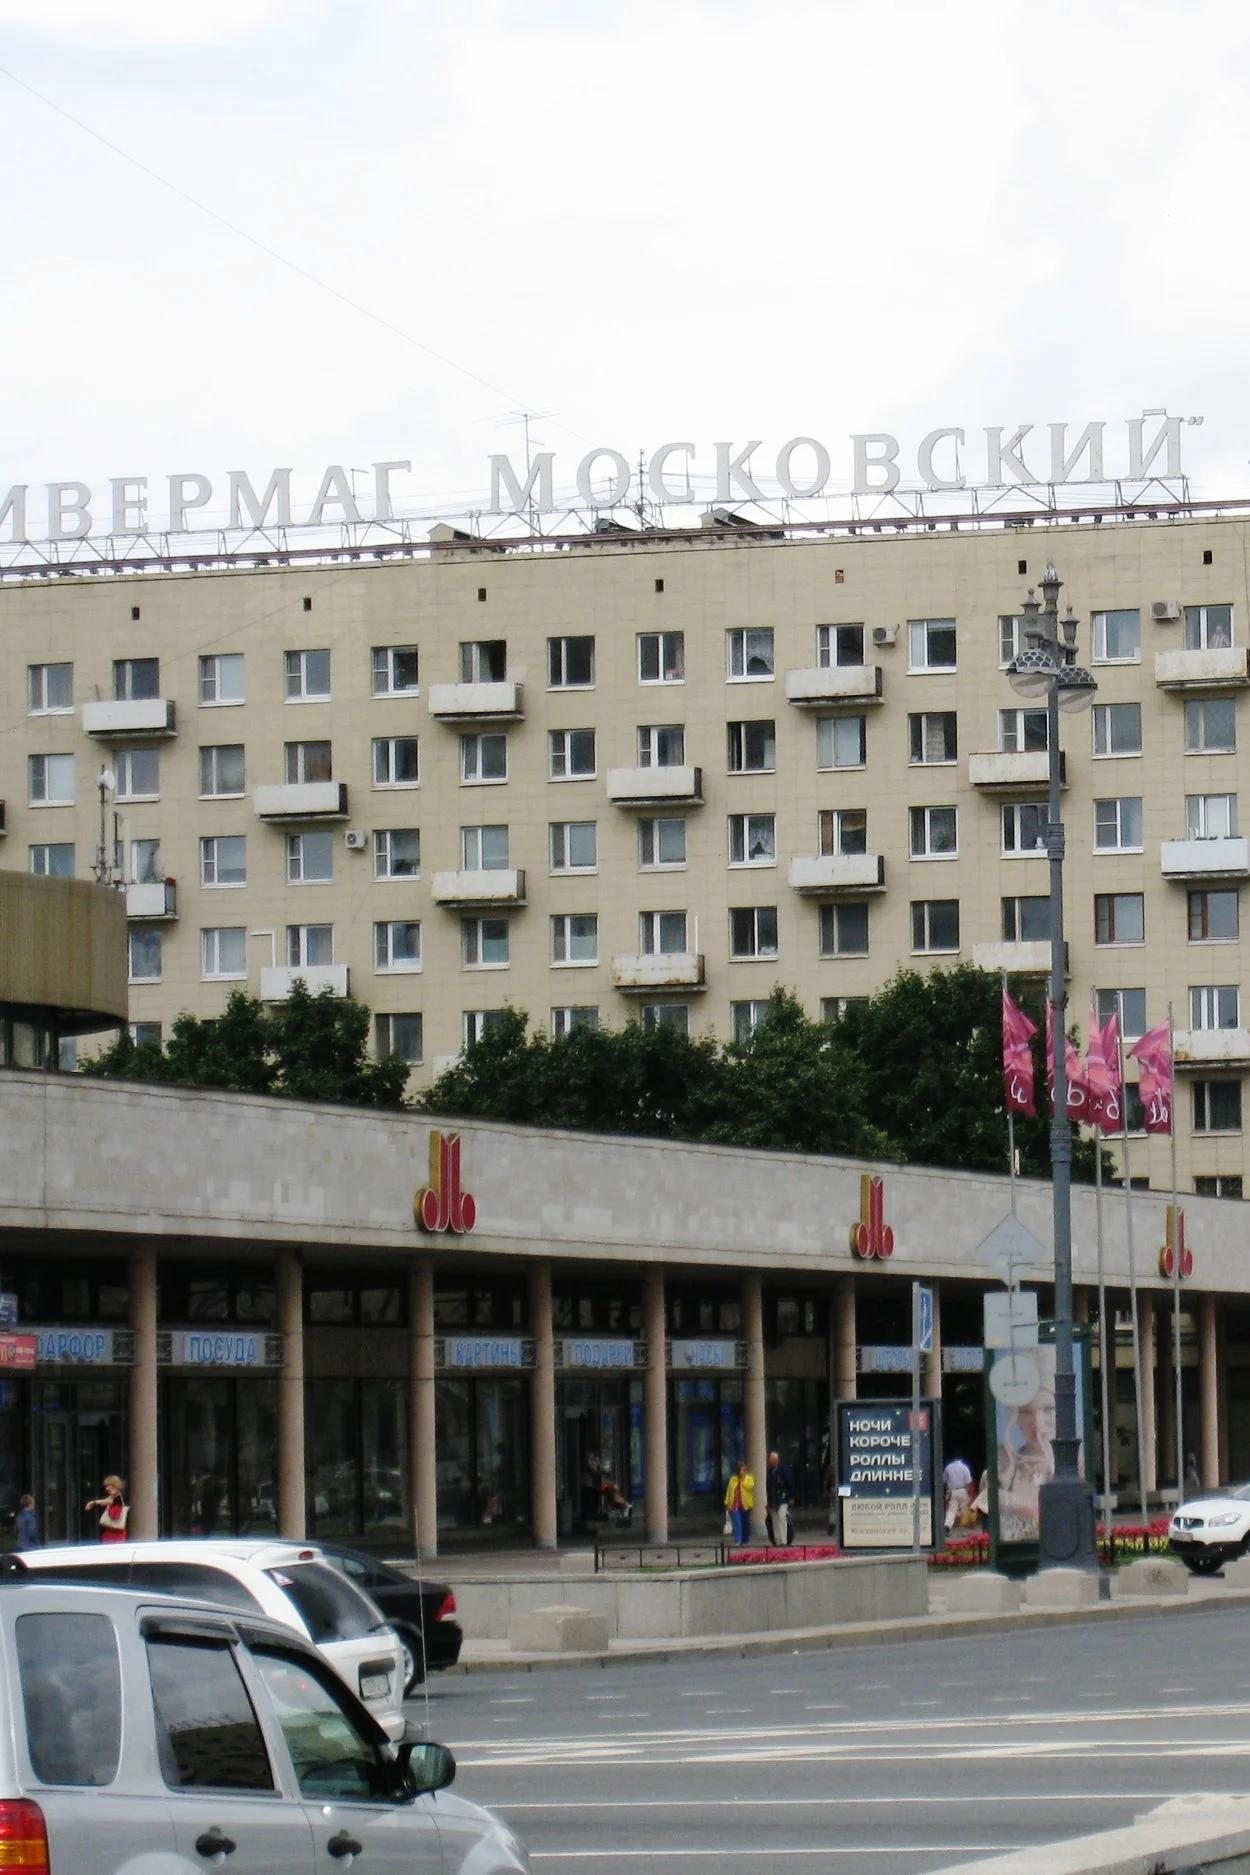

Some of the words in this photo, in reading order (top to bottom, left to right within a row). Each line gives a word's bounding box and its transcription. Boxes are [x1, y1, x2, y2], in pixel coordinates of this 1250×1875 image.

[488, 408, 1185, 513] МОСКОВСКИЙ
[190, 1335, 257, 1364] ПОСУДА
[456, 1341, 523, 1366] КАРТИНЫ
[575, 1343, 633, 1366] ПОДАРКИ
[691, 1344, 724, 1365] ЧАСЫ
[850, 1420, 892, 1432] НОЧИ
[850, 1436, 911, 1448] КОРОЧЕ
[850, 1454, 905, 1466] РОЛЛЫ
[851, 1502, 882, 1512] ЛЮБОЙ
[885, 1503, 908, 1511] РОЛЛ
